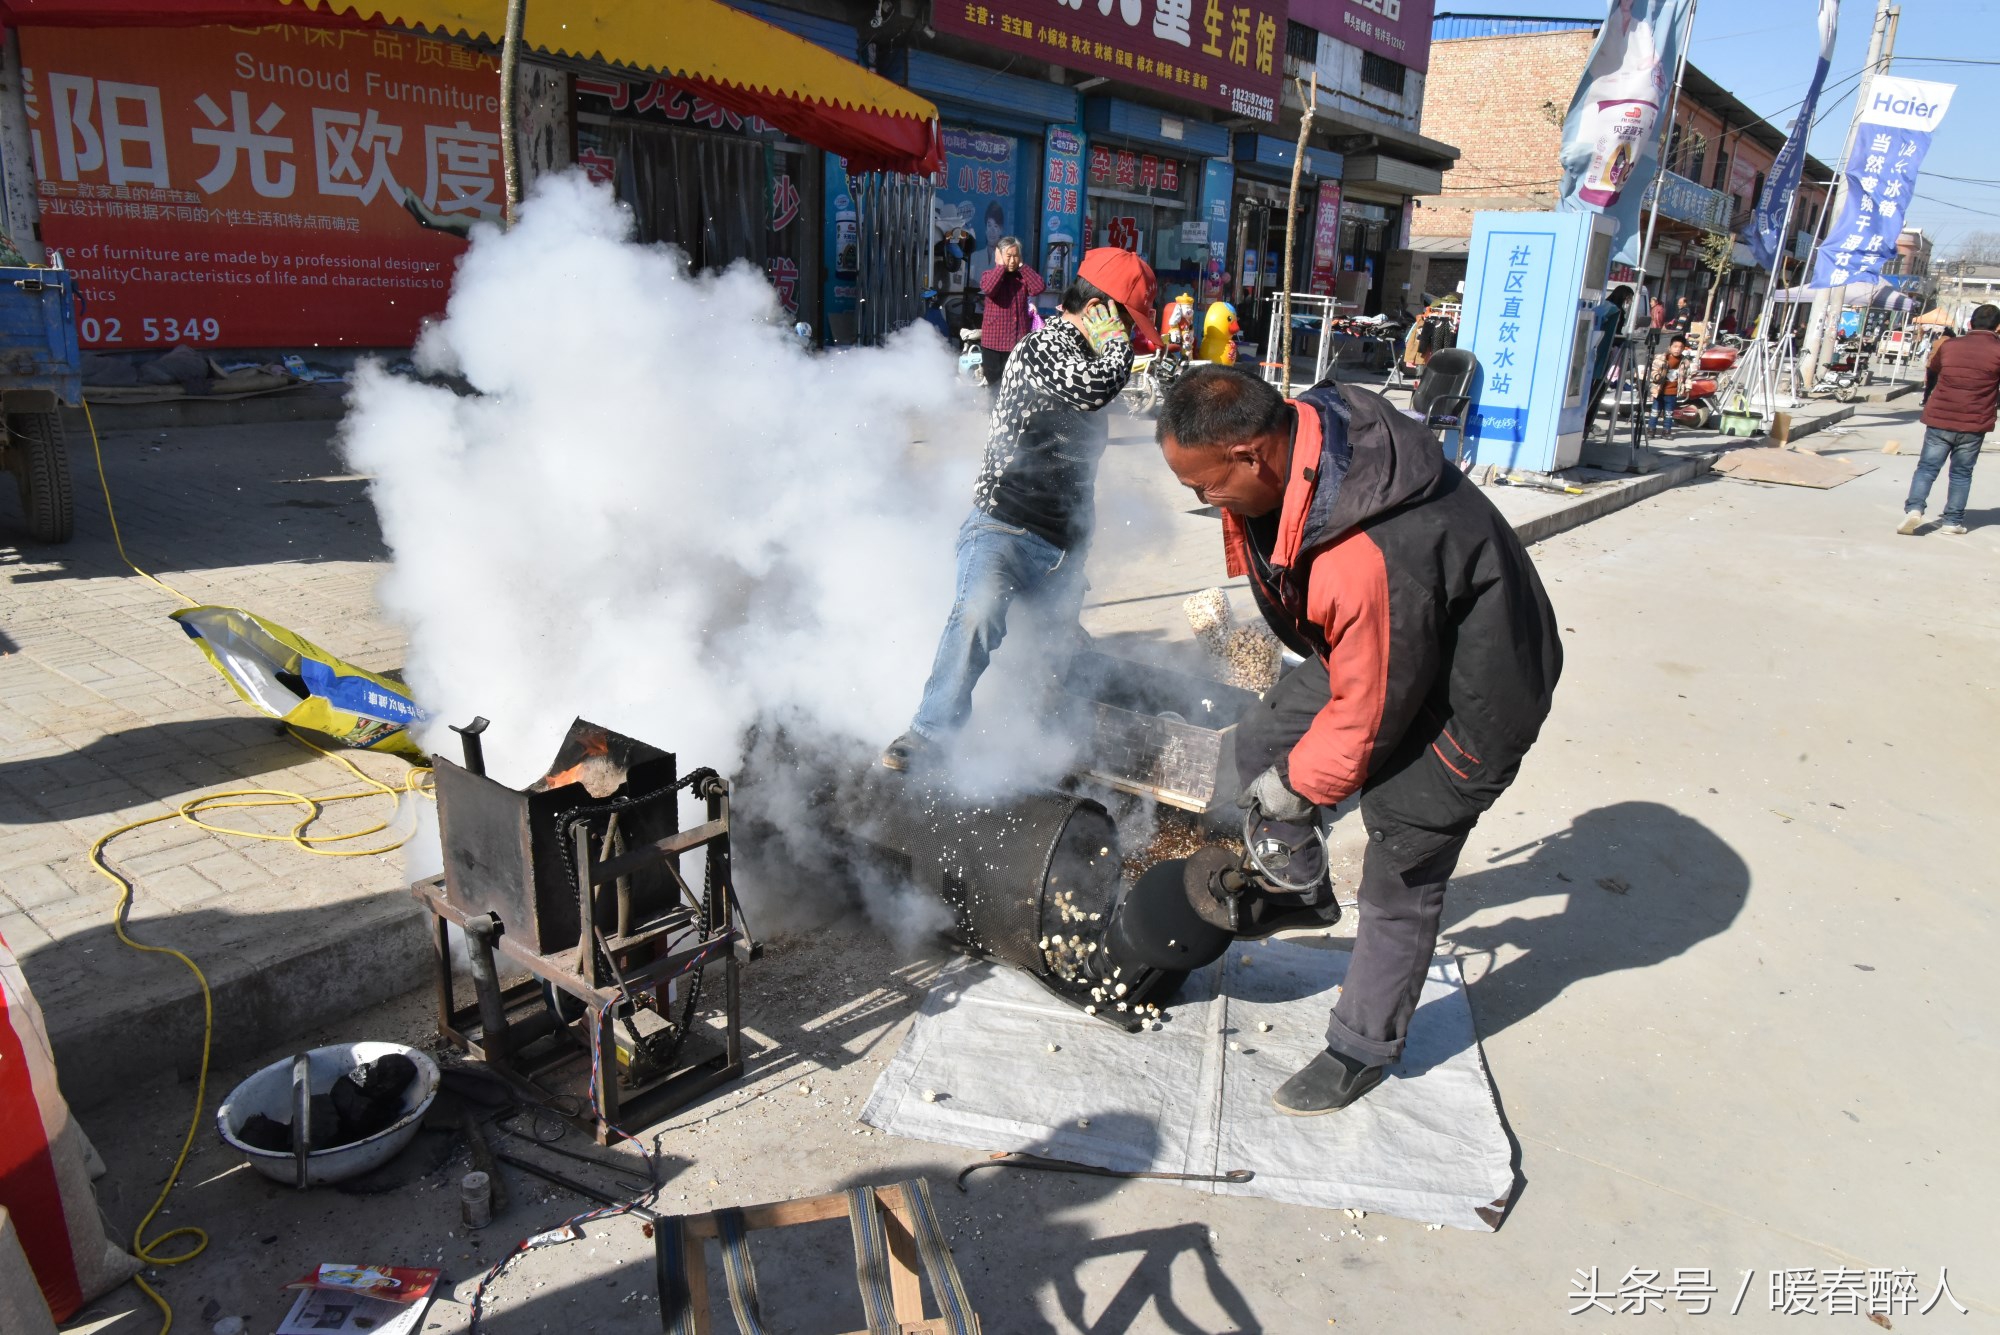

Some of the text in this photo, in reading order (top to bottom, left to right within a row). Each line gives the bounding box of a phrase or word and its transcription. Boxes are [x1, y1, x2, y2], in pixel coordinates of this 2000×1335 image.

[1001, 14, 1033, 39] 宝宝服
[1037, 26, 1068, 49] 小嫁妆
[1071, 34, 1092, 56] 秋衣
[1094, 42, 1113, 63] 秋裤
[1115, 48, 1133, 69] 保暖
[1137, 55, 1154, 73] 棉衣
[1175, 67, 1191, 85] 童车
[235, 52, 499, 113] Sunoud Furnniture
[1873, 92, 1938, 119] Haier
[958, 165, 1010, 196] 小嫁妆
[1049, 158, 1080, 186] 游泳
[1091, 145, 1178, 191] 孕婴用品
[1047, 187, 1078, 214] 洗澡
[81, 245, 99, 258] of
[104, 245, 180, 261] furniture
[184, 251, 210, 262] are
[214, 251, 257, 264] made
[261, 252, 279, 268] by
[283, 256, 291, 266] a
[295, 254, 381, 269] professional
[384, 257, 441, 273] designer
[256, 271, 271, 284] of
[274, 271, 298, 285] life
[301, 273, 328, 286] and
[332, 274, 428, 289] characteristics
[431, 278, 444, 290] to
[81, 317, 220, 342] 02 5349
[1490, 245, 1531, 394] 社区直饮水站
